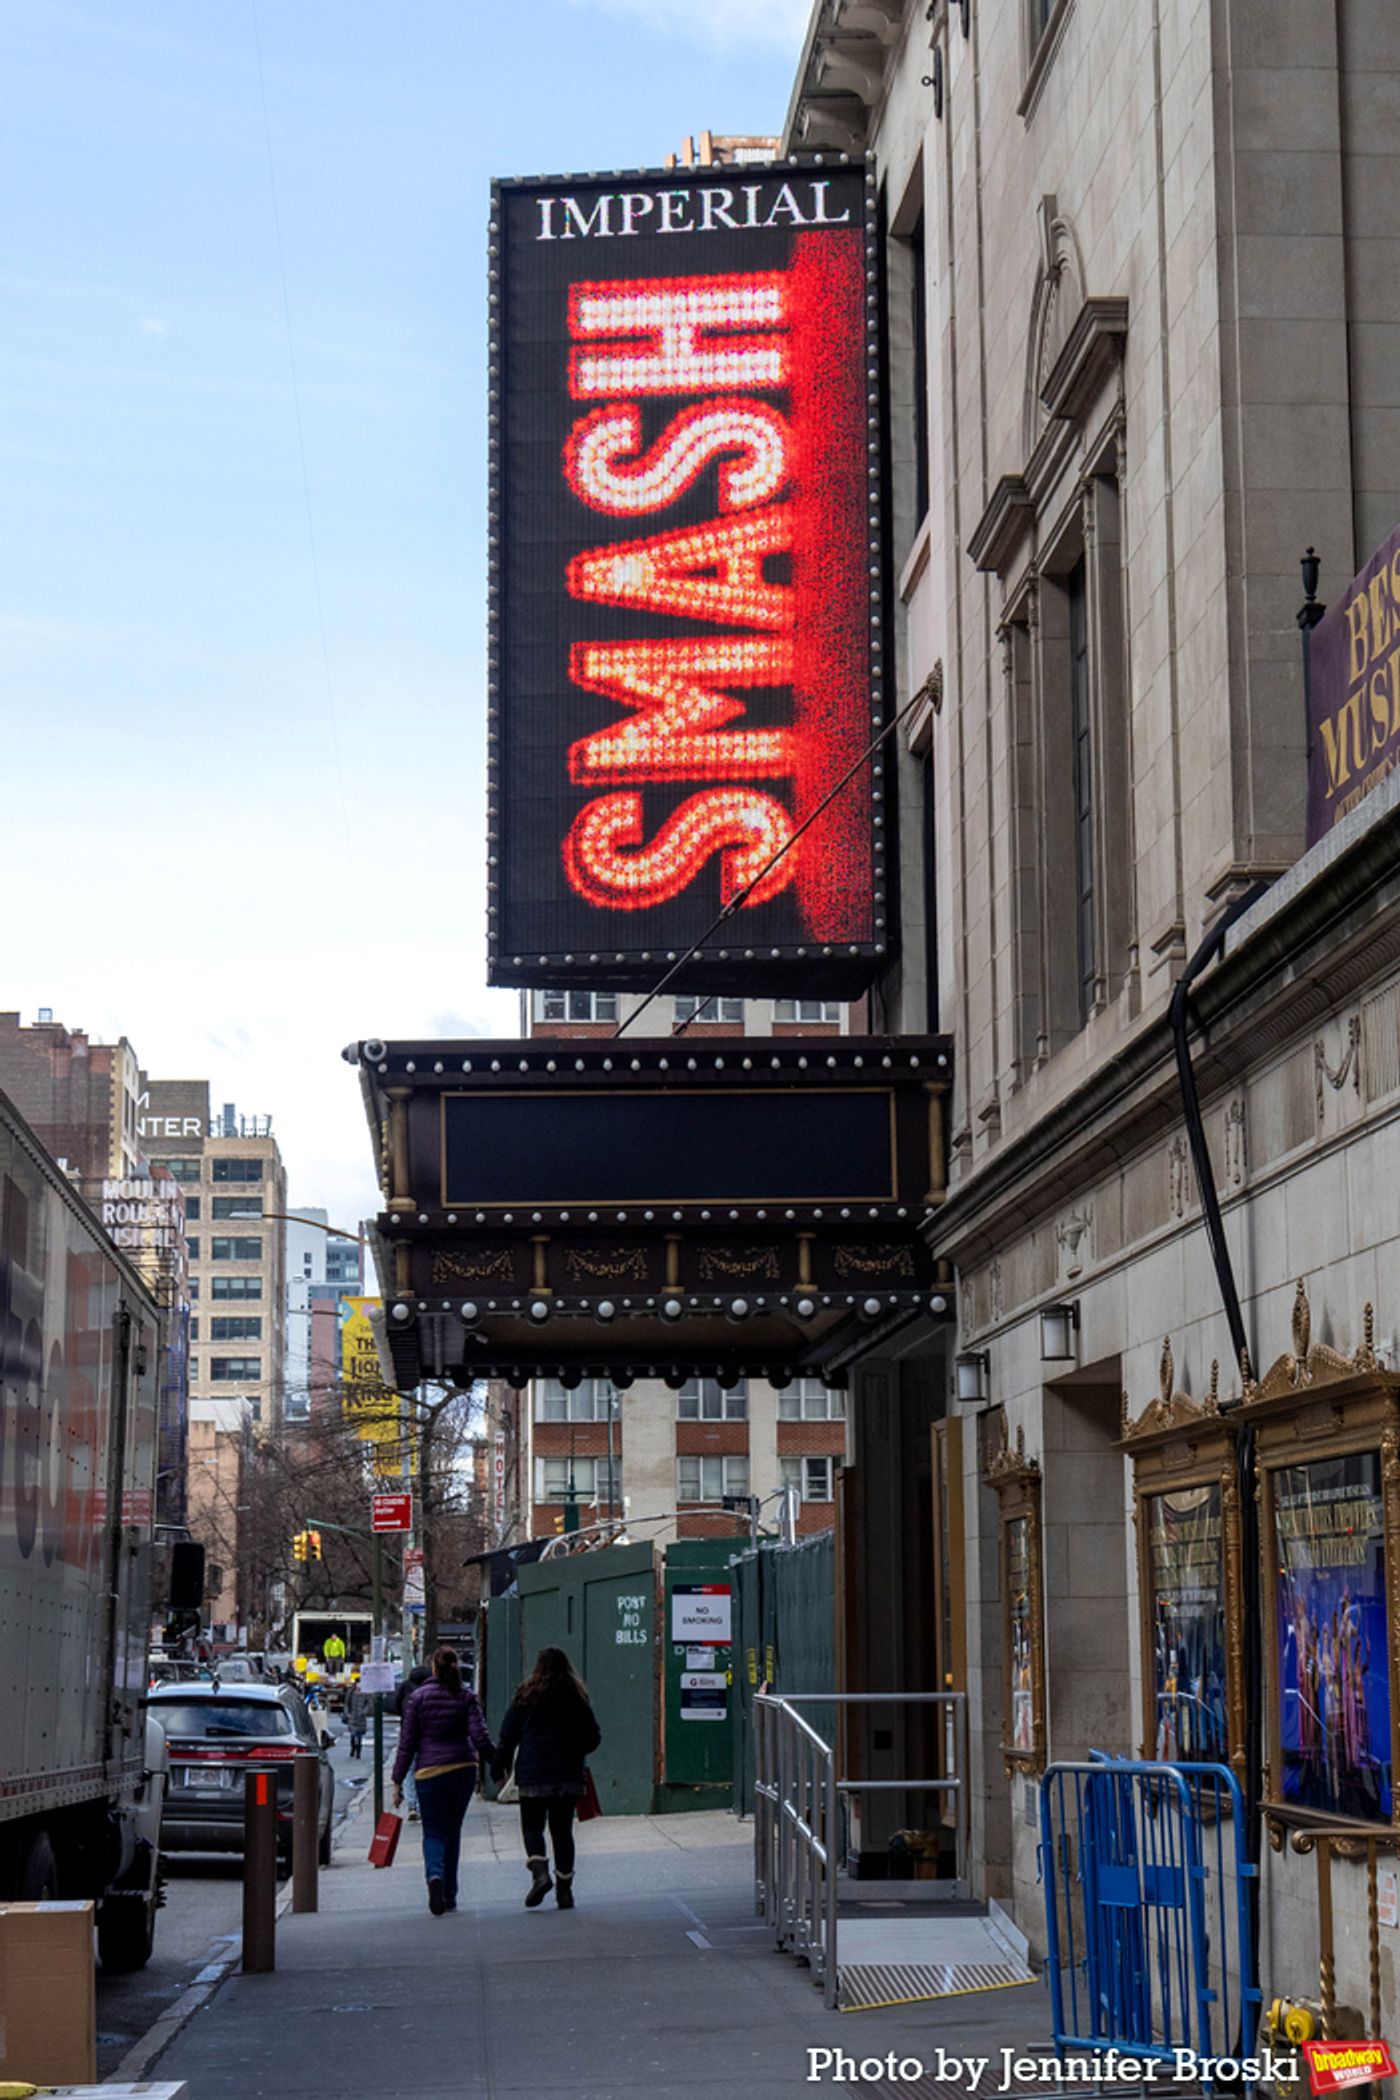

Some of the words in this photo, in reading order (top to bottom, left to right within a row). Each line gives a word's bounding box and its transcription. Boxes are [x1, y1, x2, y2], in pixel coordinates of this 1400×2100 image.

[536, 181, 850, 240] IMPERIAL
[563, 270, 797, 912] SMASH
[136, 1117, 201, 1137] NTER
[102, 1179, 178, 1199] MOULIN
[494, 1442, 505, 1523] HOTEL
[616, 1596, 646, 1609] POST
[696, 1606, 709, 1615] NO
[623, 1612, 640, 1628] NO
[682, 1616, 723, 1625] SMOKING
[616, 1630, 648, 1644] BILLS
